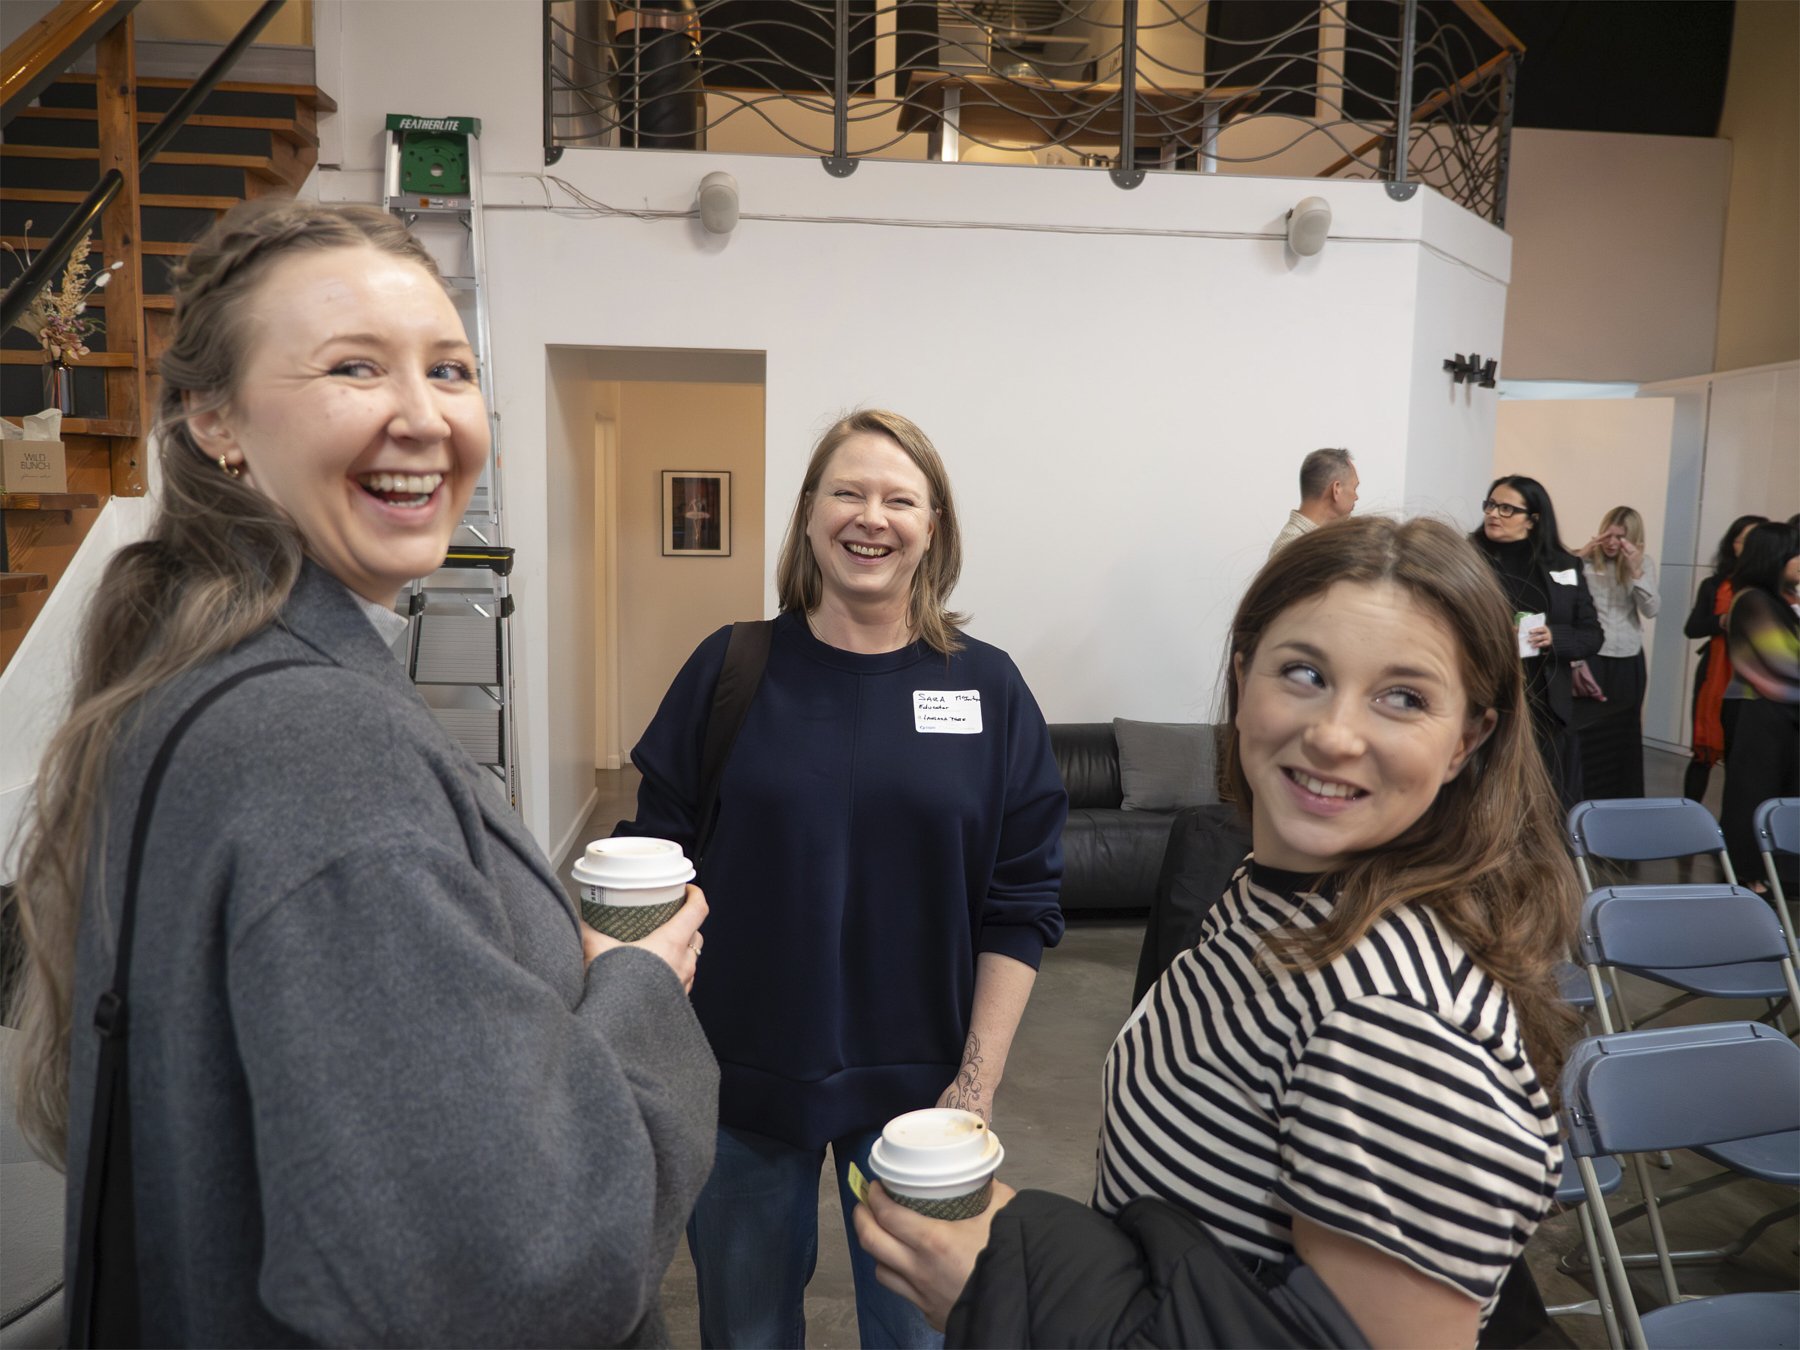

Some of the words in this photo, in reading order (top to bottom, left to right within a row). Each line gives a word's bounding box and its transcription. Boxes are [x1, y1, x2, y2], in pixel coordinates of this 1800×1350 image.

[400, 118, 459, 131] FEATHERLITE
[24, 453, 46, 461] WILD
[20, 461, 50, 470] BUNCH
[918, 693, 945, 702] SARA
